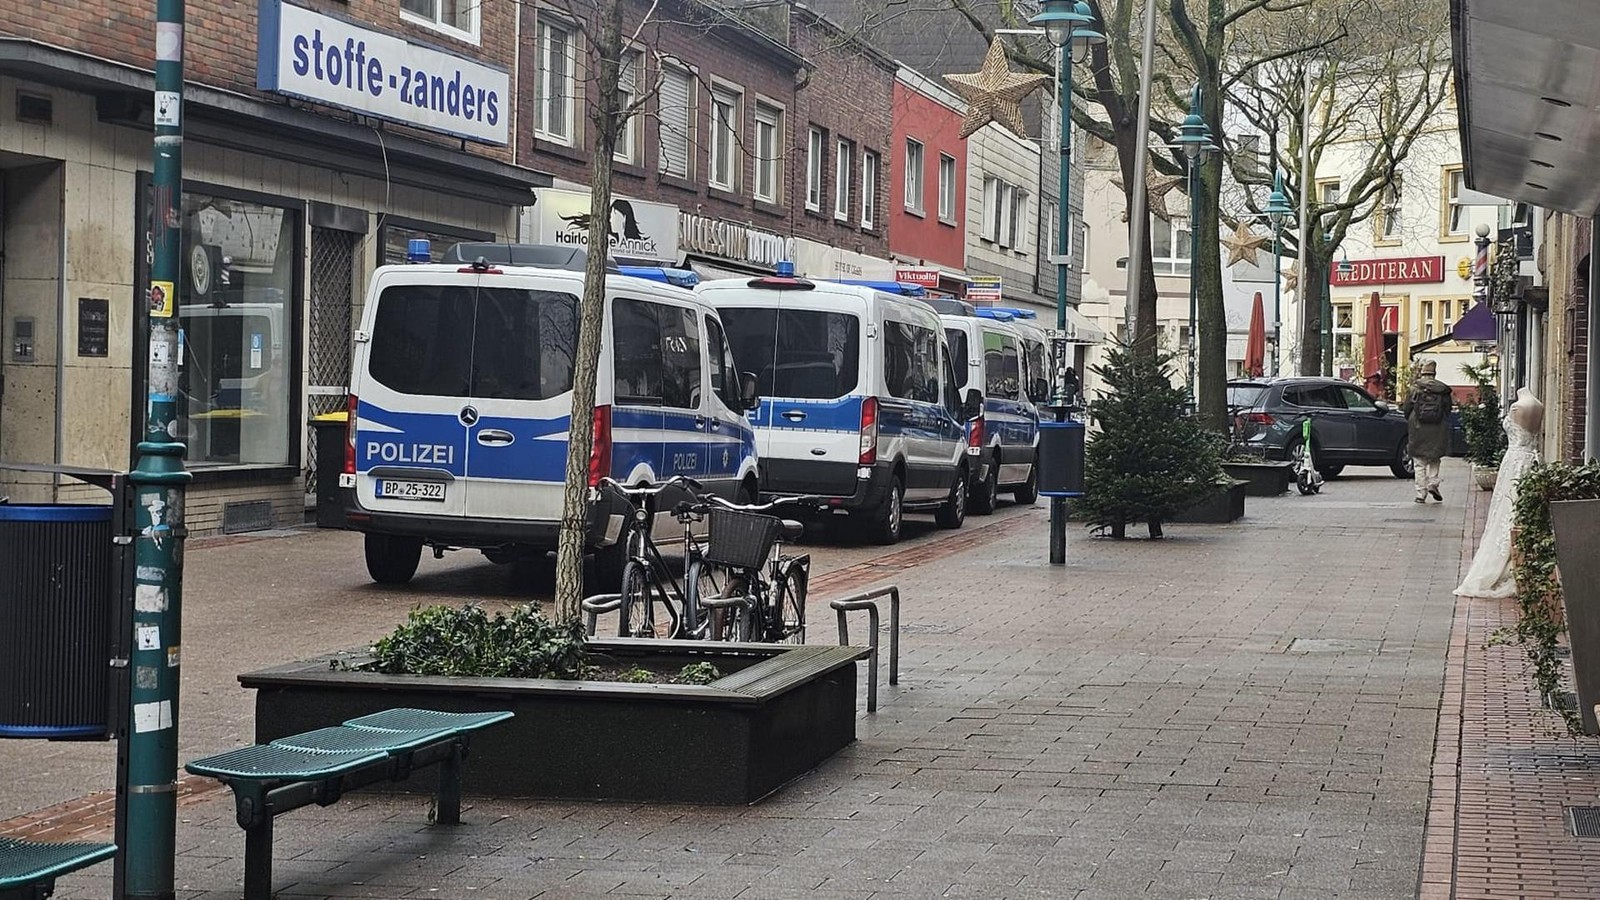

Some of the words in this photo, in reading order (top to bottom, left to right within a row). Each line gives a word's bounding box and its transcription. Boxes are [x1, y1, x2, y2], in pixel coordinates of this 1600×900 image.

[555, 230, 617, 248] Hairloe
[620, 237, 657, 253] Annick
[746, 228, 785, 266] TATTOO
[366, 441, 454, 465] POLIZEI
[672, 452, 698, 471] POLIZEI
[385, 482, 398, 495] BP
[405, 483, 441, 497] 25-322
